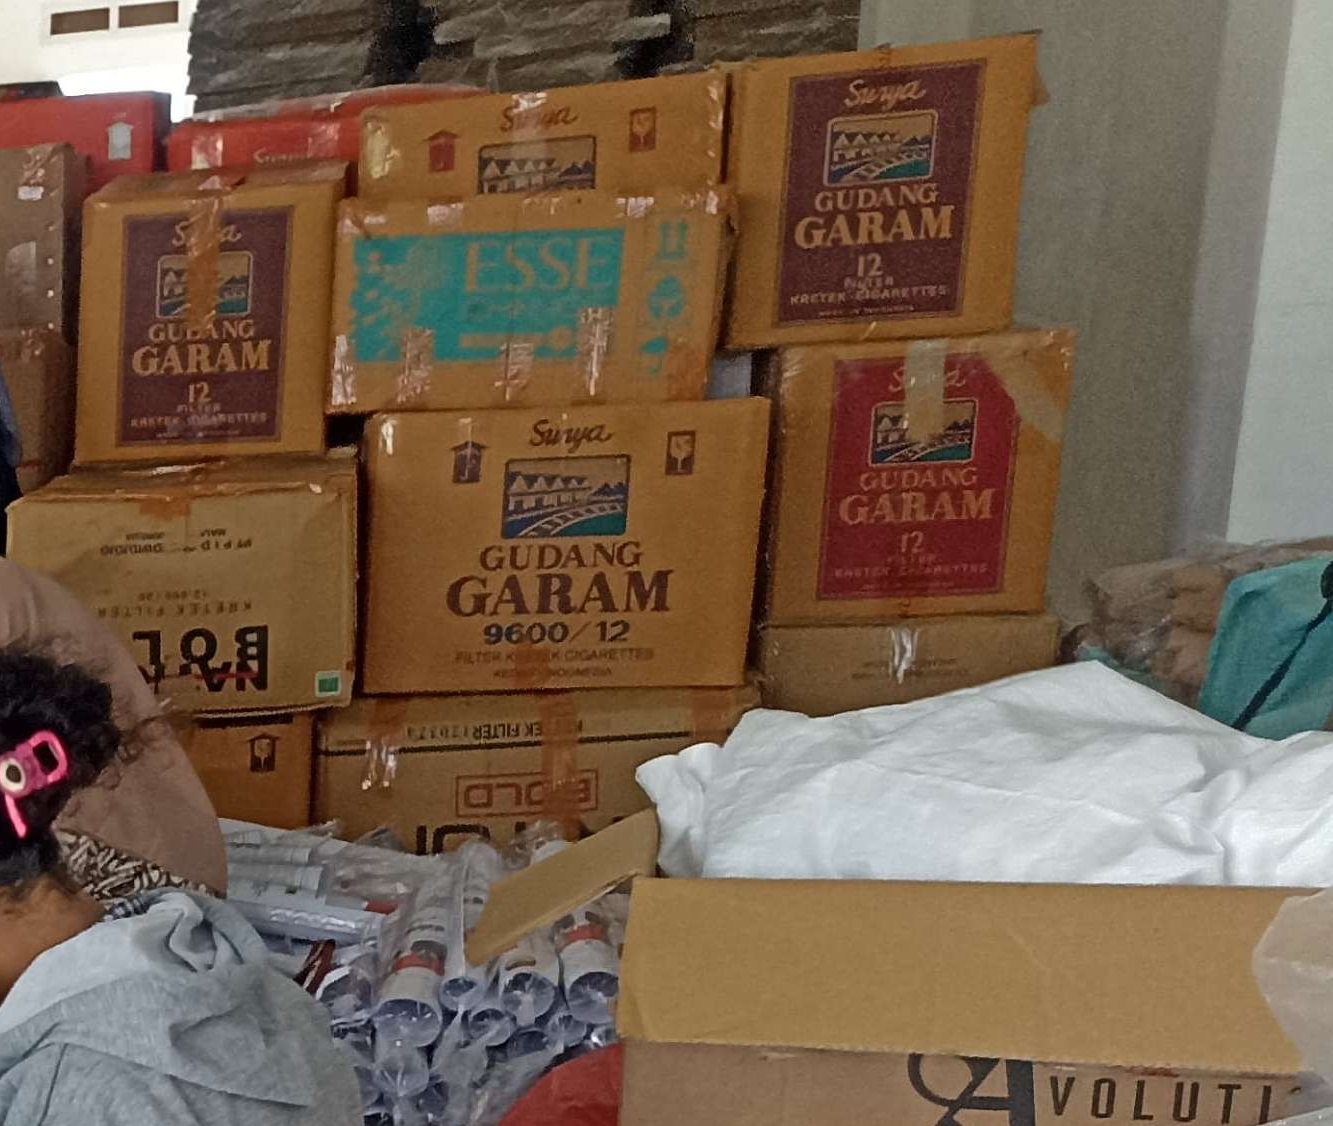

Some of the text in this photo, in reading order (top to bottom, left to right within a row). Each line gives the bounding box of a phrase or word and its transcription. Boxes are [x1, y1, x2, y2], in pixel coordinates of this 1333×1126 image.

[814, 183, 940, 212] GUDANG
[794, 205, 955, 249] GARAM
[465, 236, 614, 292] ESSE
[856, 252, 884, 277] 12
[131, 339, 272, 376] GARAM
[188, 381, 212, 402] 12
[529, 418, 613, 454] Surya
[859, 466, 978, 491] GUDANG
[838, 487, 996, 525] GARAM
[479, 541, 643, 571] GUDANG
[446, 569, 676, 618] GARAM
